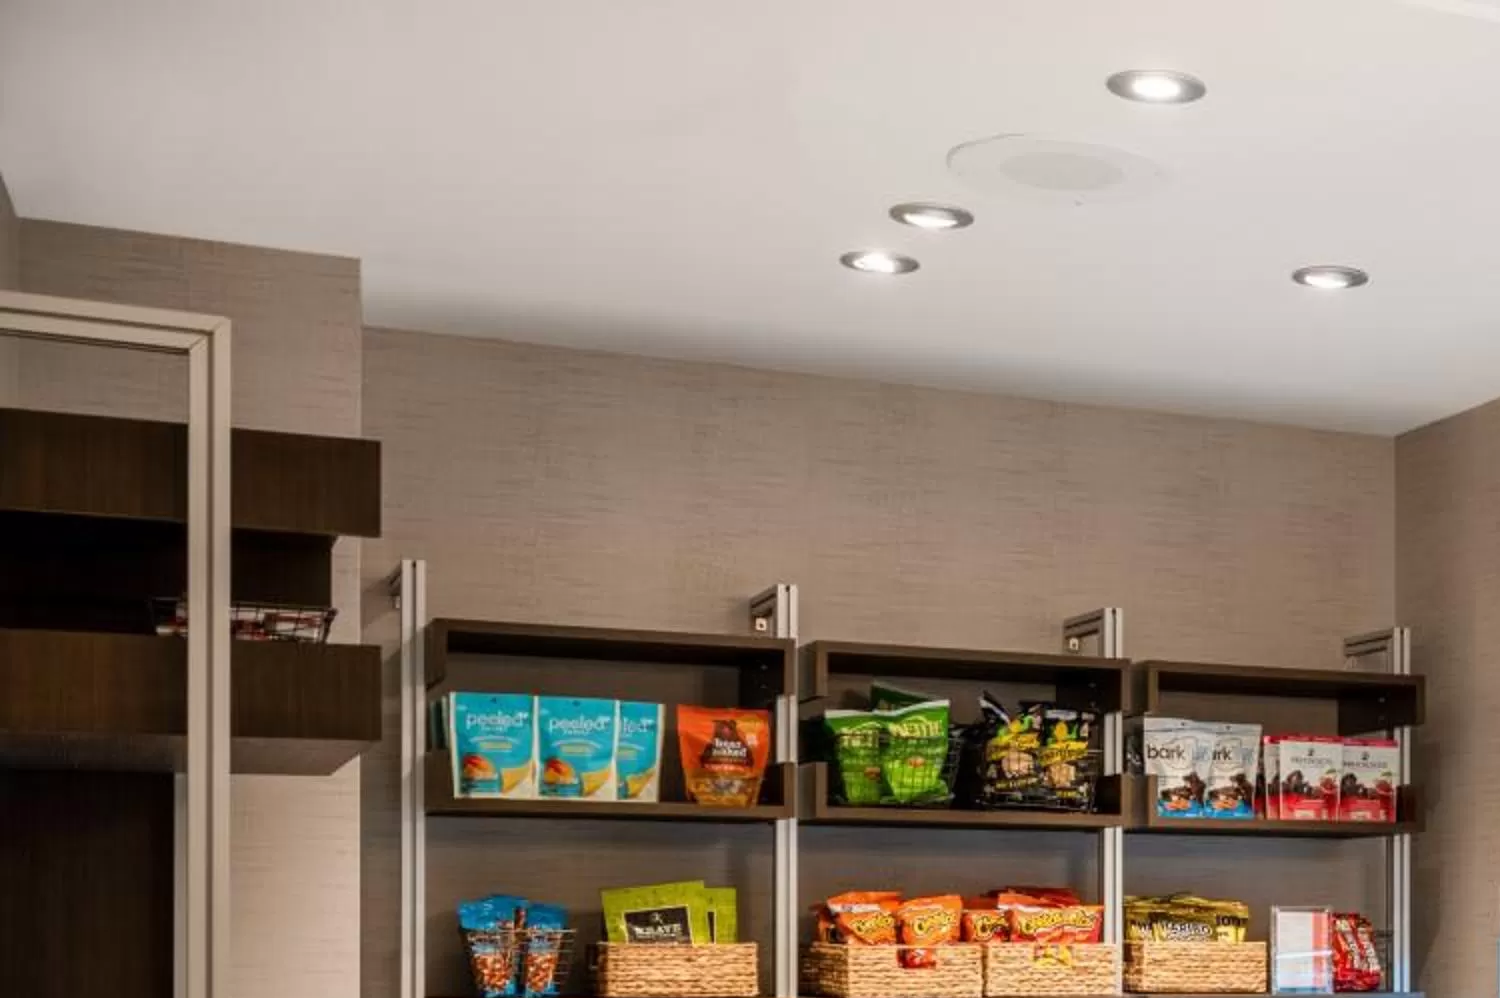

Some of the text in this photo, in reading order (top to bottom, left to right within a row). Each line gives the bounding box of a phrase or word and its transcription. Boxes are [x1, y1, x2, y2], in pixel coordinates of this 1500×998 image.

[466, 712, 526, 731] peeled
[549, 716, 609, 733] peeled
[623, 717, 652, 733] led
[1147, 743, 1186, 760] bark
